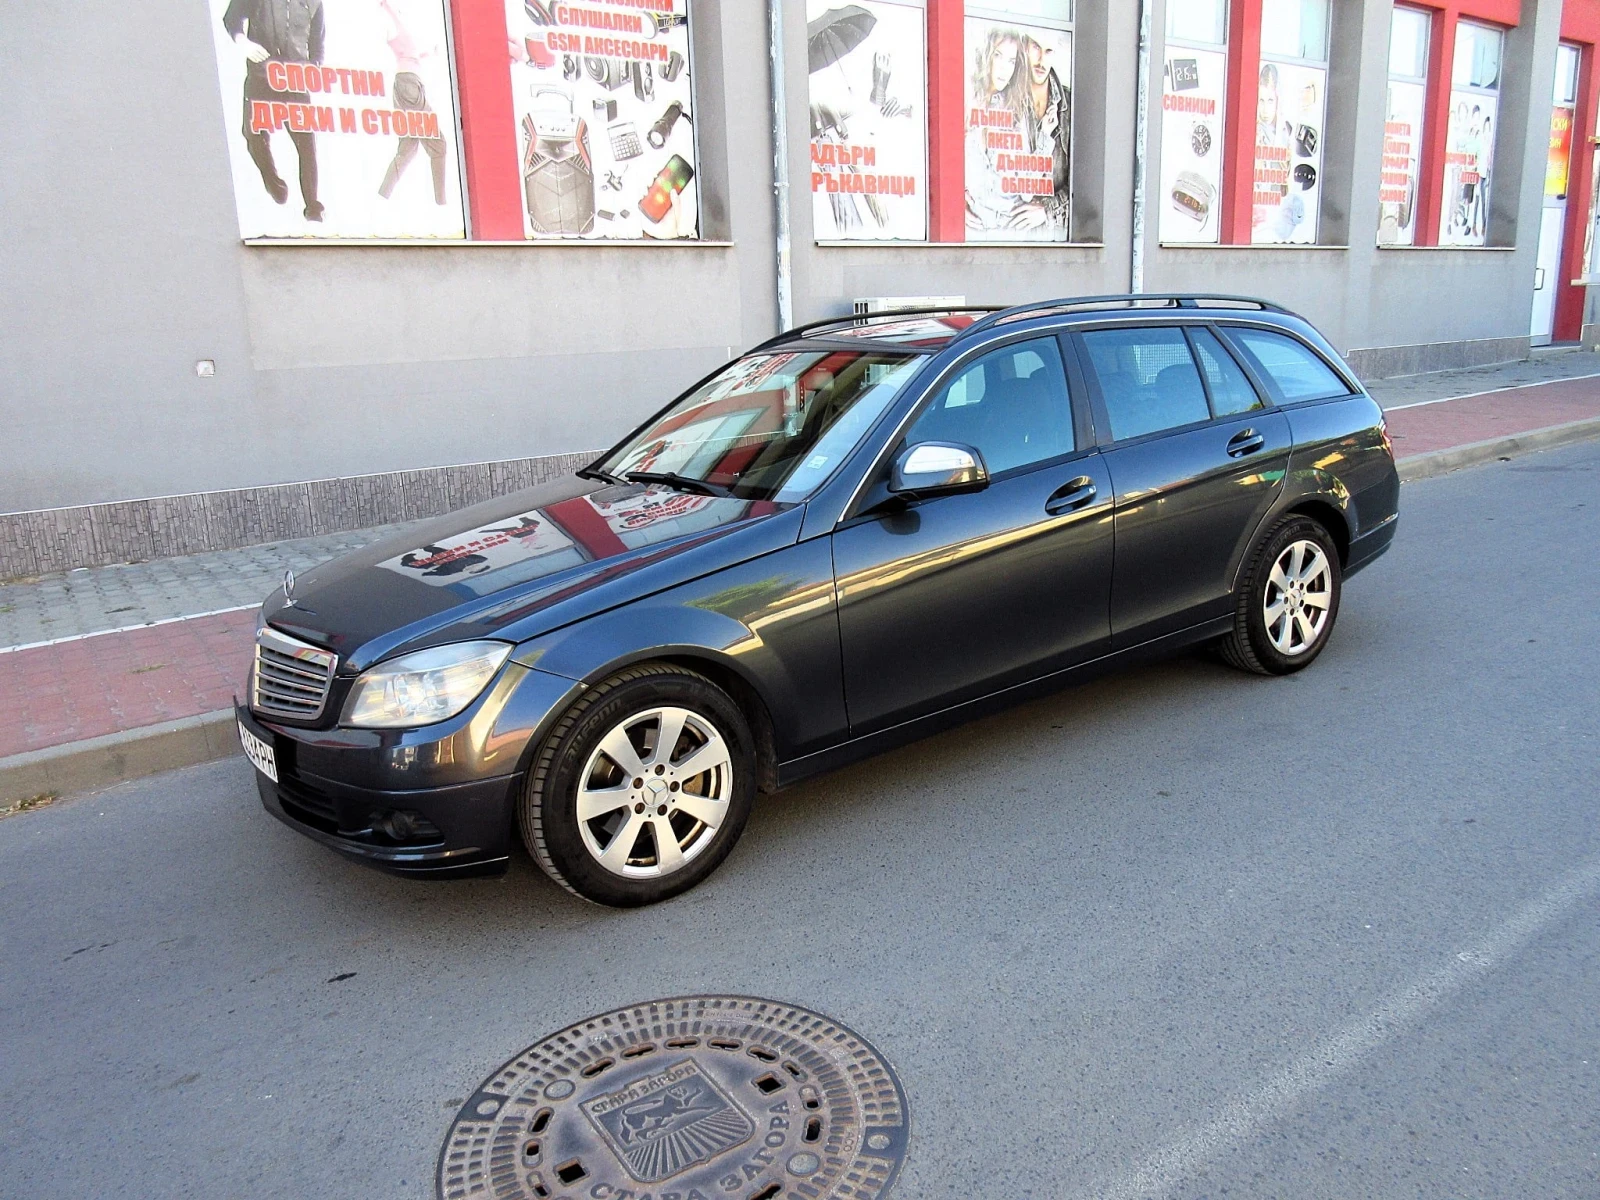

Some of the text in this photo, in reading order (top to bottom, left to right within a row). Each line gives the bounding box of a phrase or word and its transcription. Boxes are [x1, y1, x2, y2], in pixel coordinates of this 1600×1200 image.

[557, 6, 643, 33] СЛУШАЛКИ
[547, 32, 668, 61] GSM АКСЕСОАРИ
[267, 62, 385, 96] СПОРТНИ
[1163, 94, 1215, 117] СОВНИЦИ
[251, 102, 440, 138] ДРЕХИ И СТОКИ
[969, 108, 1013, 128] ДЪНКИ
[987, 132, 1023, 150] ЯКЕТА
[810, 143, 876, 167] АДЪРИ
[996, 153, 1053, 172] ДЪНКОВИ
[1256, 145, 1288, 161] ОЛАНИ
[811, 172, 915, 198] РЪКАВИЦИ
[1001, 176, 1053, 195] ОБЛЕКЛА
